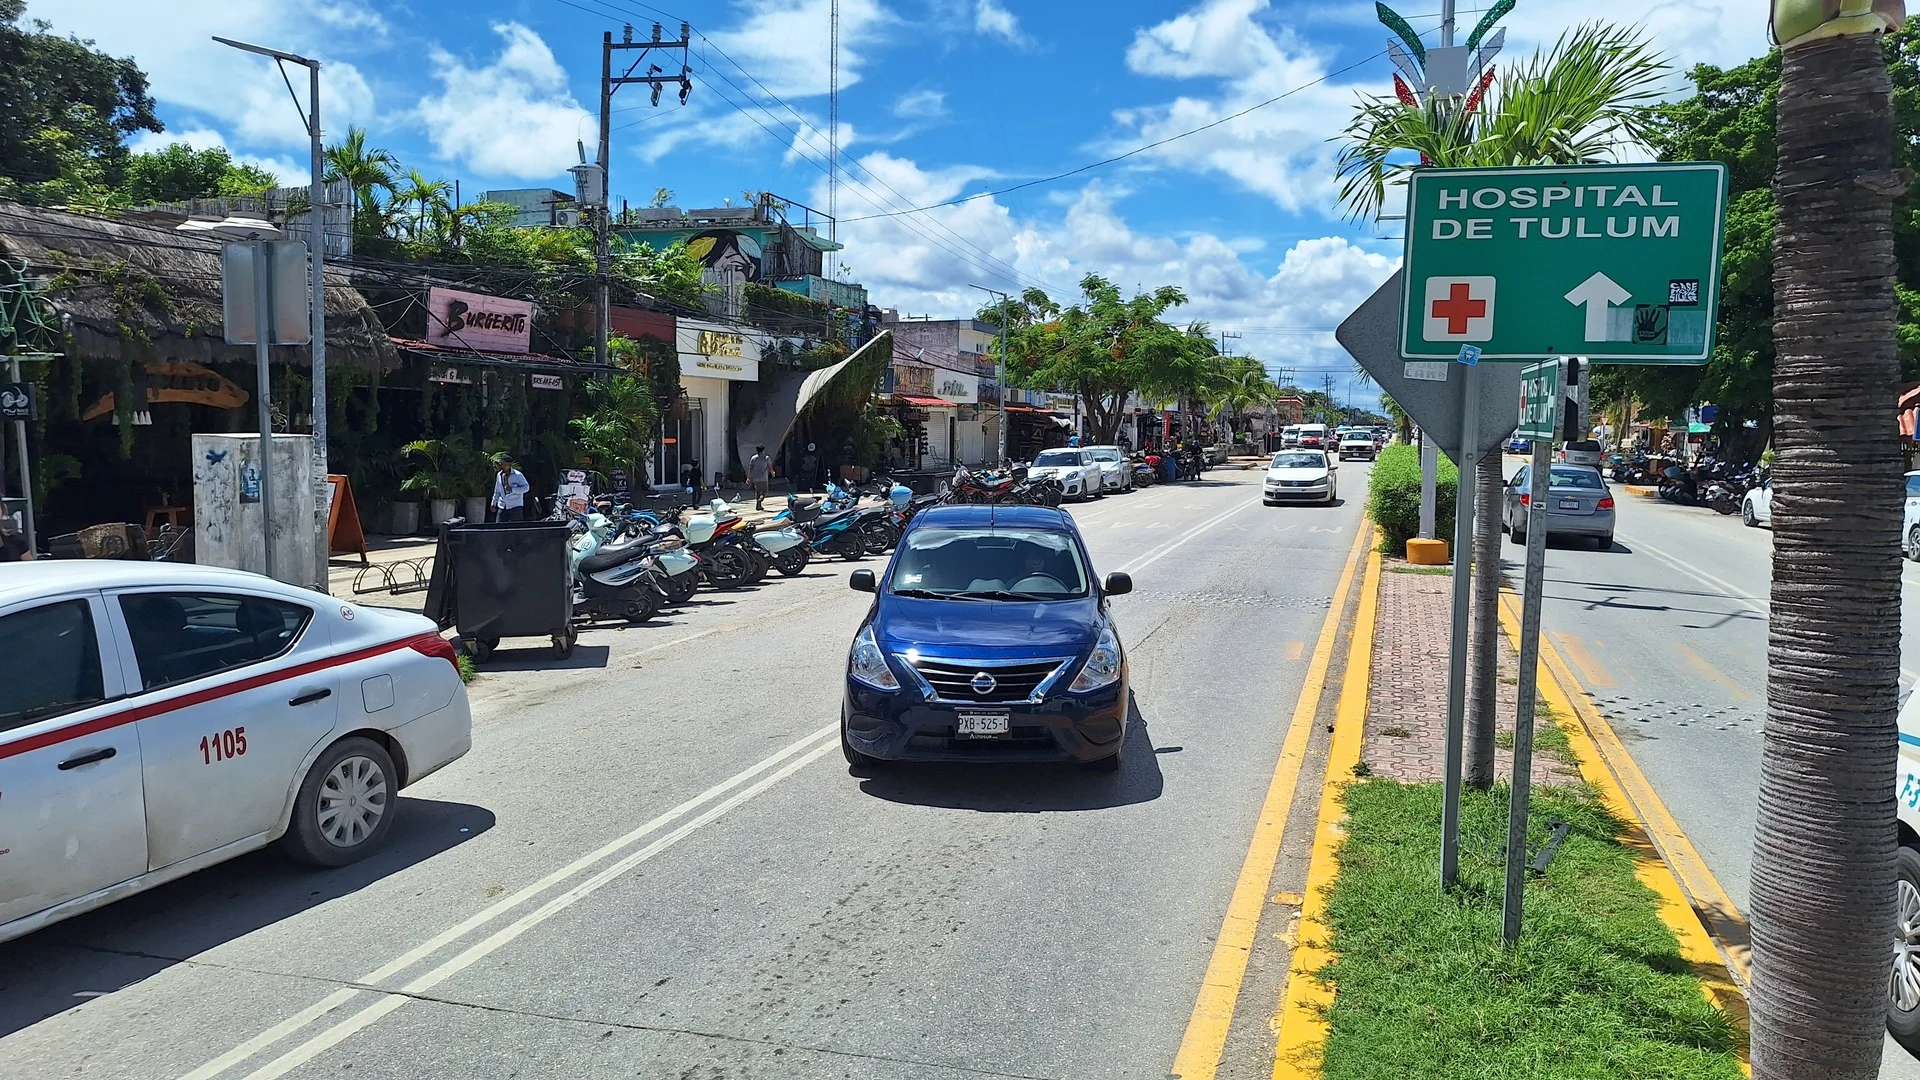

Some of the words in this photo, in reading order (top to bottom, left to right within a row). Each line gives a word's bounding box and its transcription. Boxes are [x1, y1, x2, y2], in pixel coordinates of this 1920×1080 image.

[1438, 185, 1679, 210] HOSPITAL
[1431, 218, 1494, 239] DE
[1509, 215, 1680, 238] TULUM
[440, 299, 528, 337] BURGERITO
[959, 718, 1009, 730] PXB-525-D
[200, 726, 247, 765] 1105
